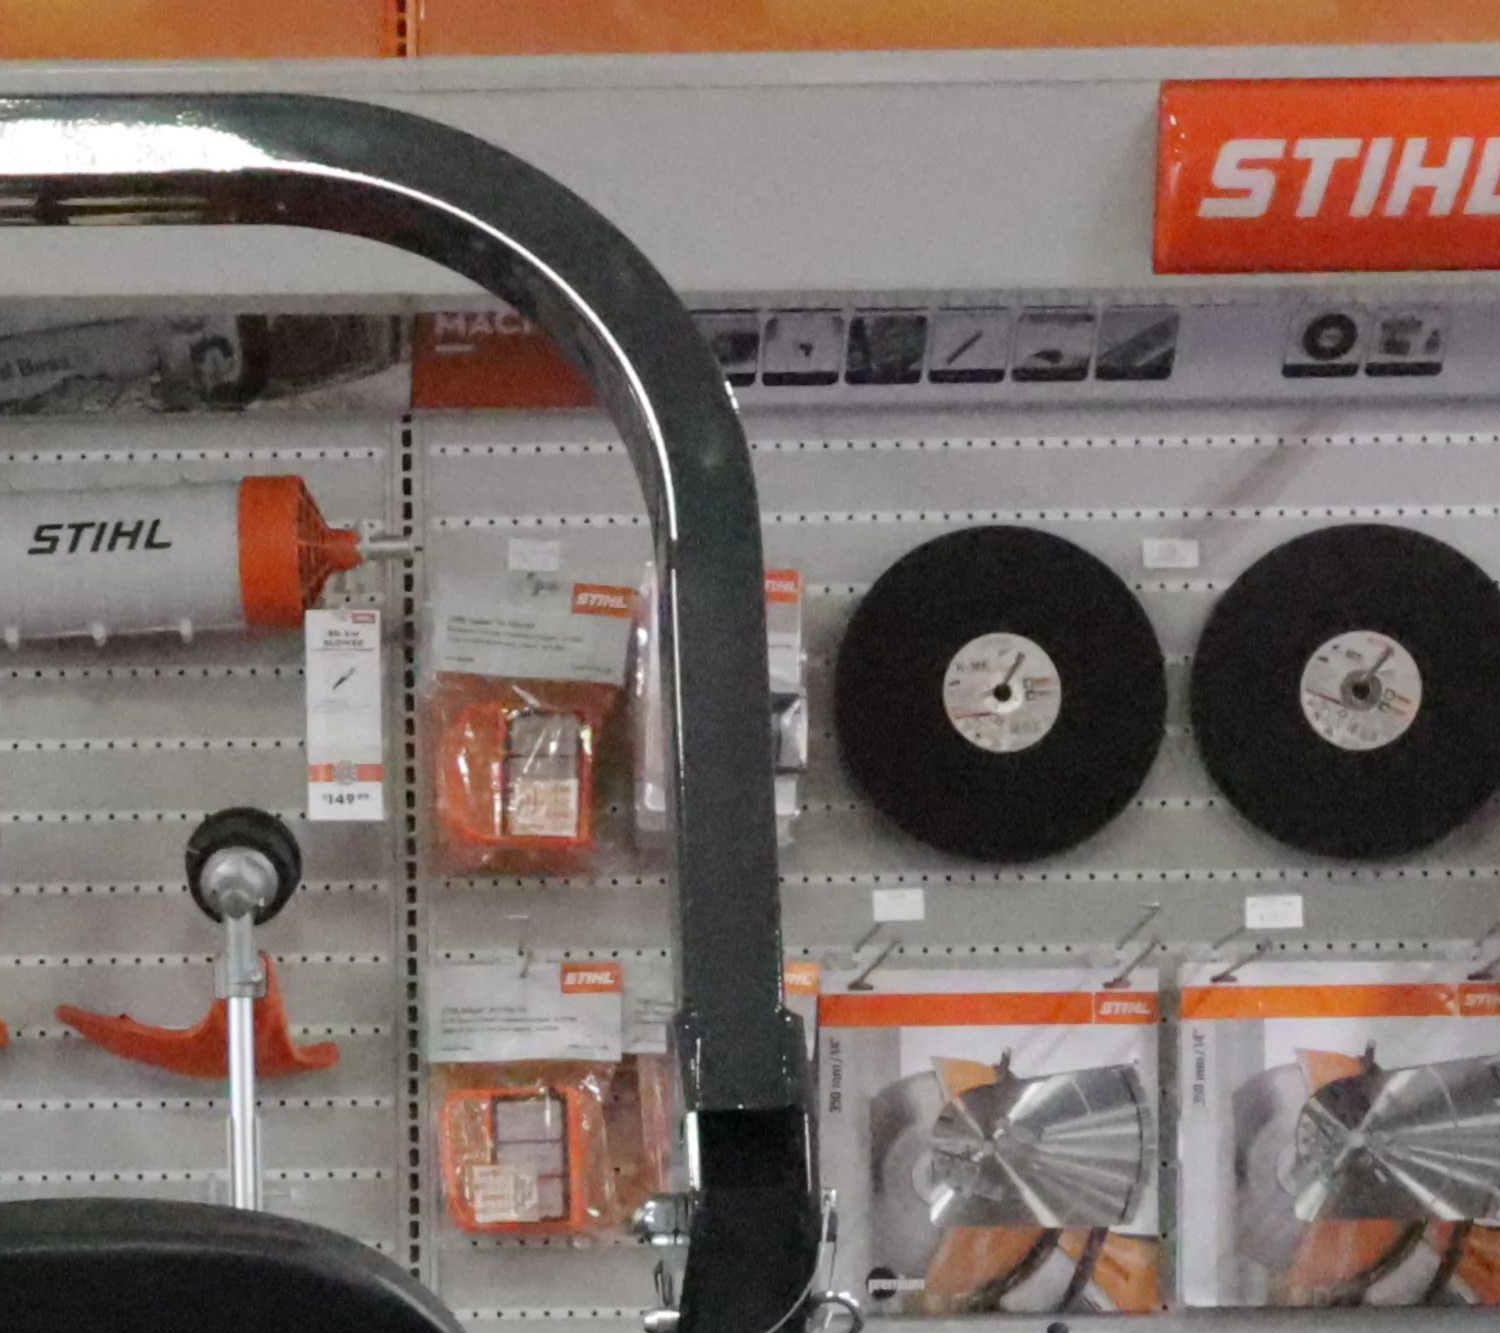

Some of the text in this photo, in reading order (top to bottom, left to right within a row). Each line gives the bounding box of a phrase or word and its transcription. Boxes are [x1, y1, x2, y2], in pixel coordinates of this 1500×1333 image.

[27, 518, 173, 556] STIHL
[576, 591, 629, 610] STIHL
[564, 971, 616, 986] STIHL
[1100, 1000, 1153, 1017] STIHL
